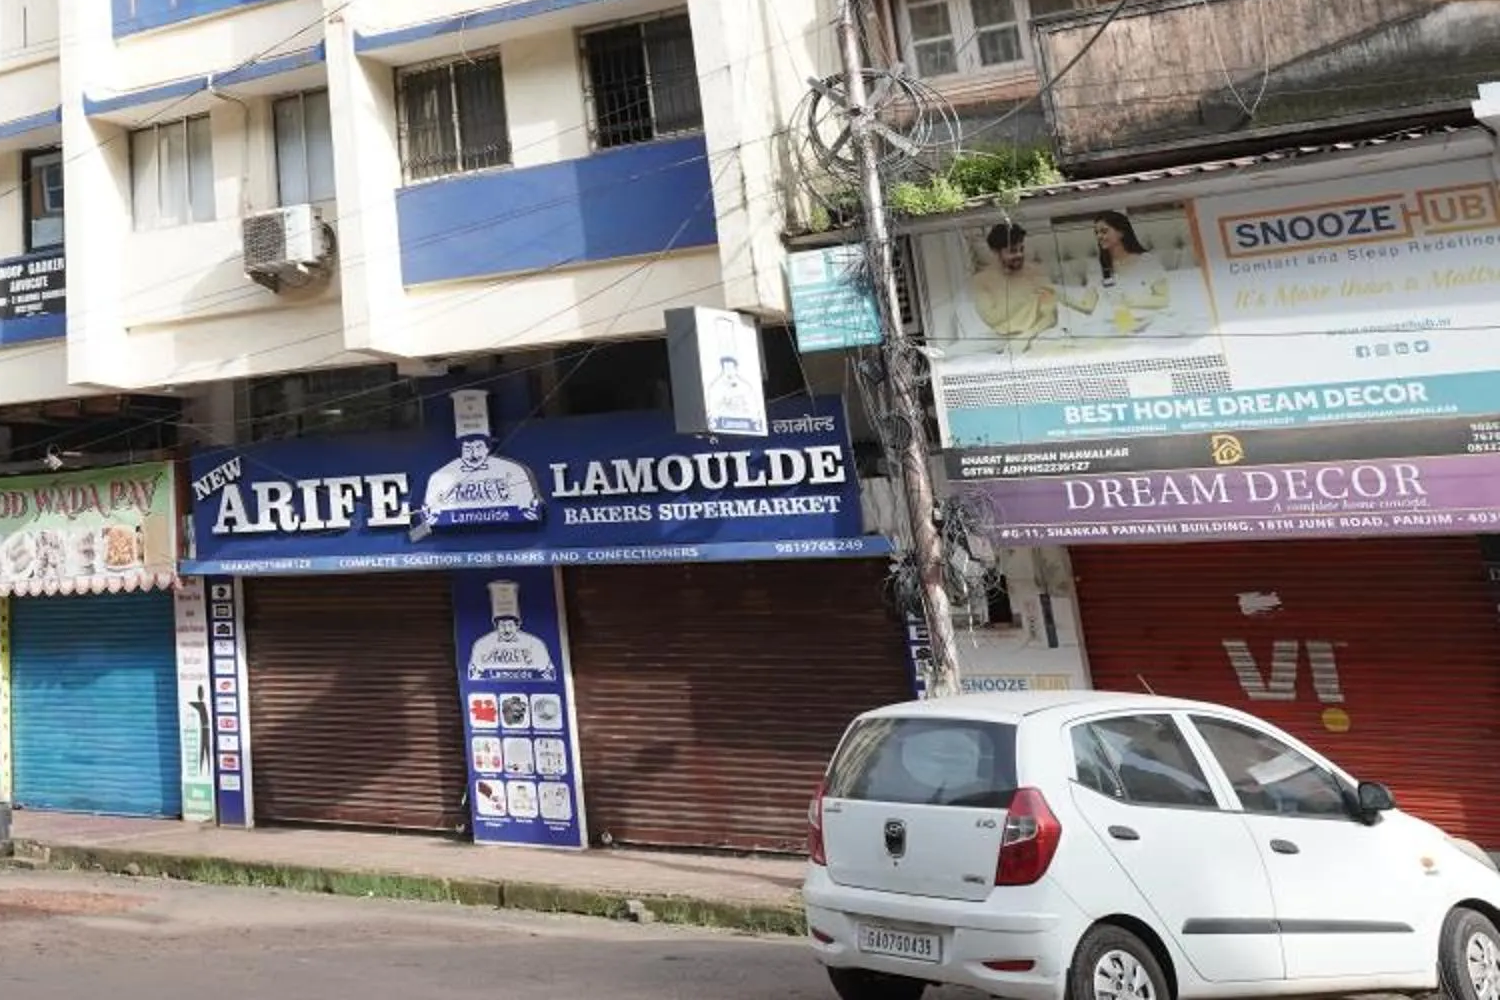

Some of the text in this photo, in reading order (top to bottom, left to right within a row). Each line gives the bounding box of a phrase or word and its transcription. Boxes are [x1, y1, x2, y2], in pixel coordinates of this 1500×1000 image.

[1235, 205, 1396, 248] SNOOZE
[1228, 257, 1299, 275] Comfort
[1306, 252, 1338, 265] and
[1347, 246, 1400, 261] Sleep
[1064, 402, 1127, 425] BEST
[1134, 397, 1214, 420] HOME
[1218, 391, 1318, 417] DREAM
[1323, 381, 1429, 409] DECOR
[192, 456, 242, 501] NEW
[550, 445, 846, 498] LAMOULDE
[1063, 463, 1428, 511] DREAM DECOR
[33, 481, 111, 522] WADA
[211, 472, 411, 534] ARIFE
[563, 495, 842, 525] BAKERS SUPERMARKET
[1047, 526, 1109, 538] SHANKAR
[1112, 524, 1178, 536] PARVATHI
[1299, 517, 1335, 530] JUNE
[1393, 513, 1453, 526] PANJIM
[339, 546, 699, 569] COMPLETE SOLUTION FOR BAKERS AND CONFECTIONERS
[960, 679, 1029, 692] SNOOZE
